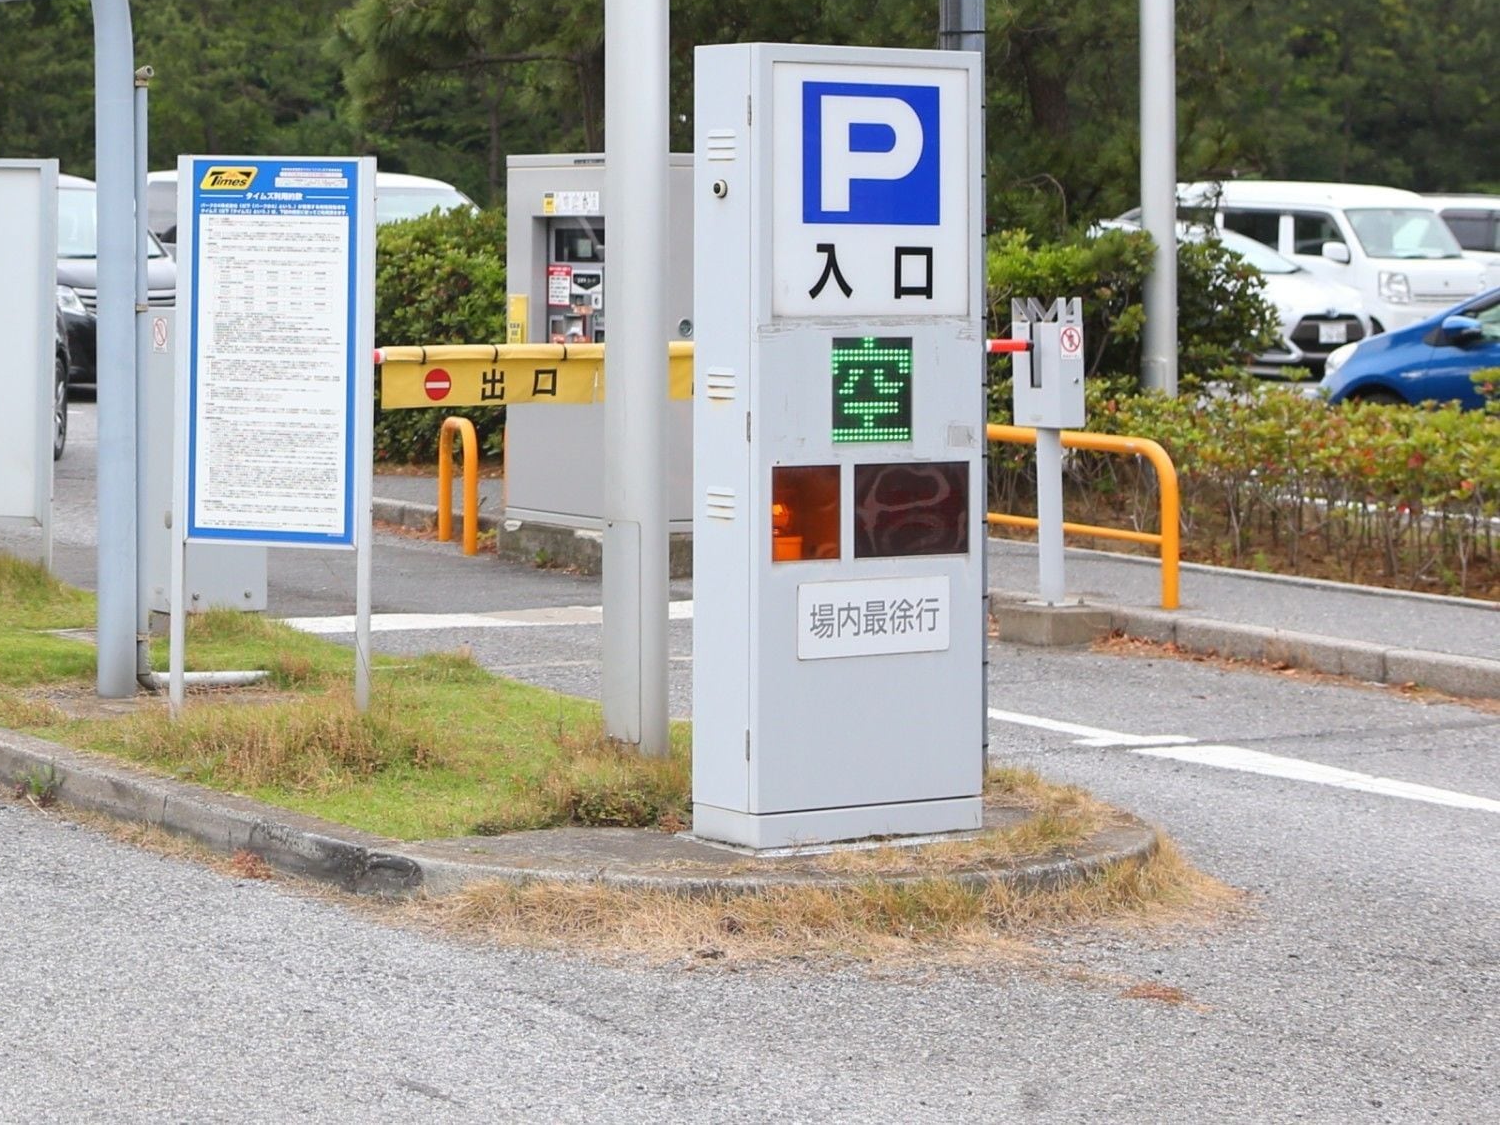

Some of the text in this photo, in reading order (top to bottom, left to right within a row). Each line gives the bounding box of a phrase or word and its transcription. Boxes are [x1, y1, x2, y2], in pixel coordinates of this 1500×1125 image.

[820, 94, 924, 212] P
[209, 171, 248, 187] Times
[808, 243, 934, 300] 入口
[481, 368, 558, 401] 出口
[833, 336, 909, 441] 空
[809, 597, 940, 639] 場内最徐行
